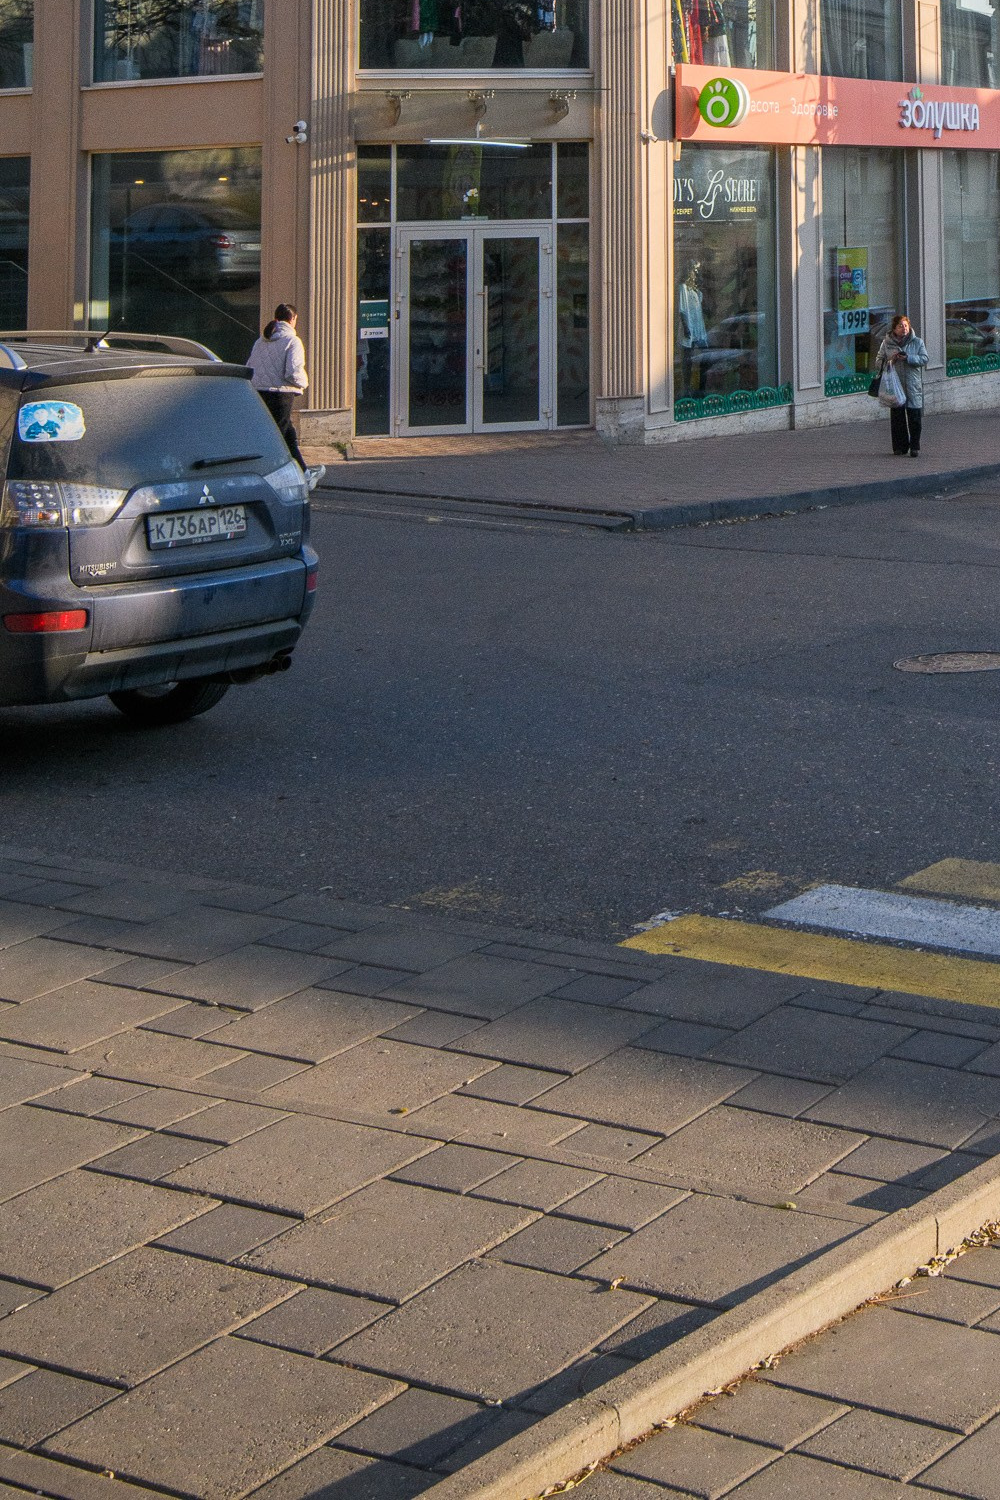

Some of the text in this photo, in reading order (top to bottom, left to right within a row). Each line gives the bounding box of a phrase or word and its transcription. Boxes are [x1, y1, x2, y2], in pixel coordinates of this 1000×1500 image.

[750, 97, 839, 118] асота Здоровье
[899, 100, 980, 139] ЗОЛУШКА
[724, 179, 762, 202] SECRET
[219, 508, 242, 526] 126
[79, 561, 117, 573] MITSUBISHI
